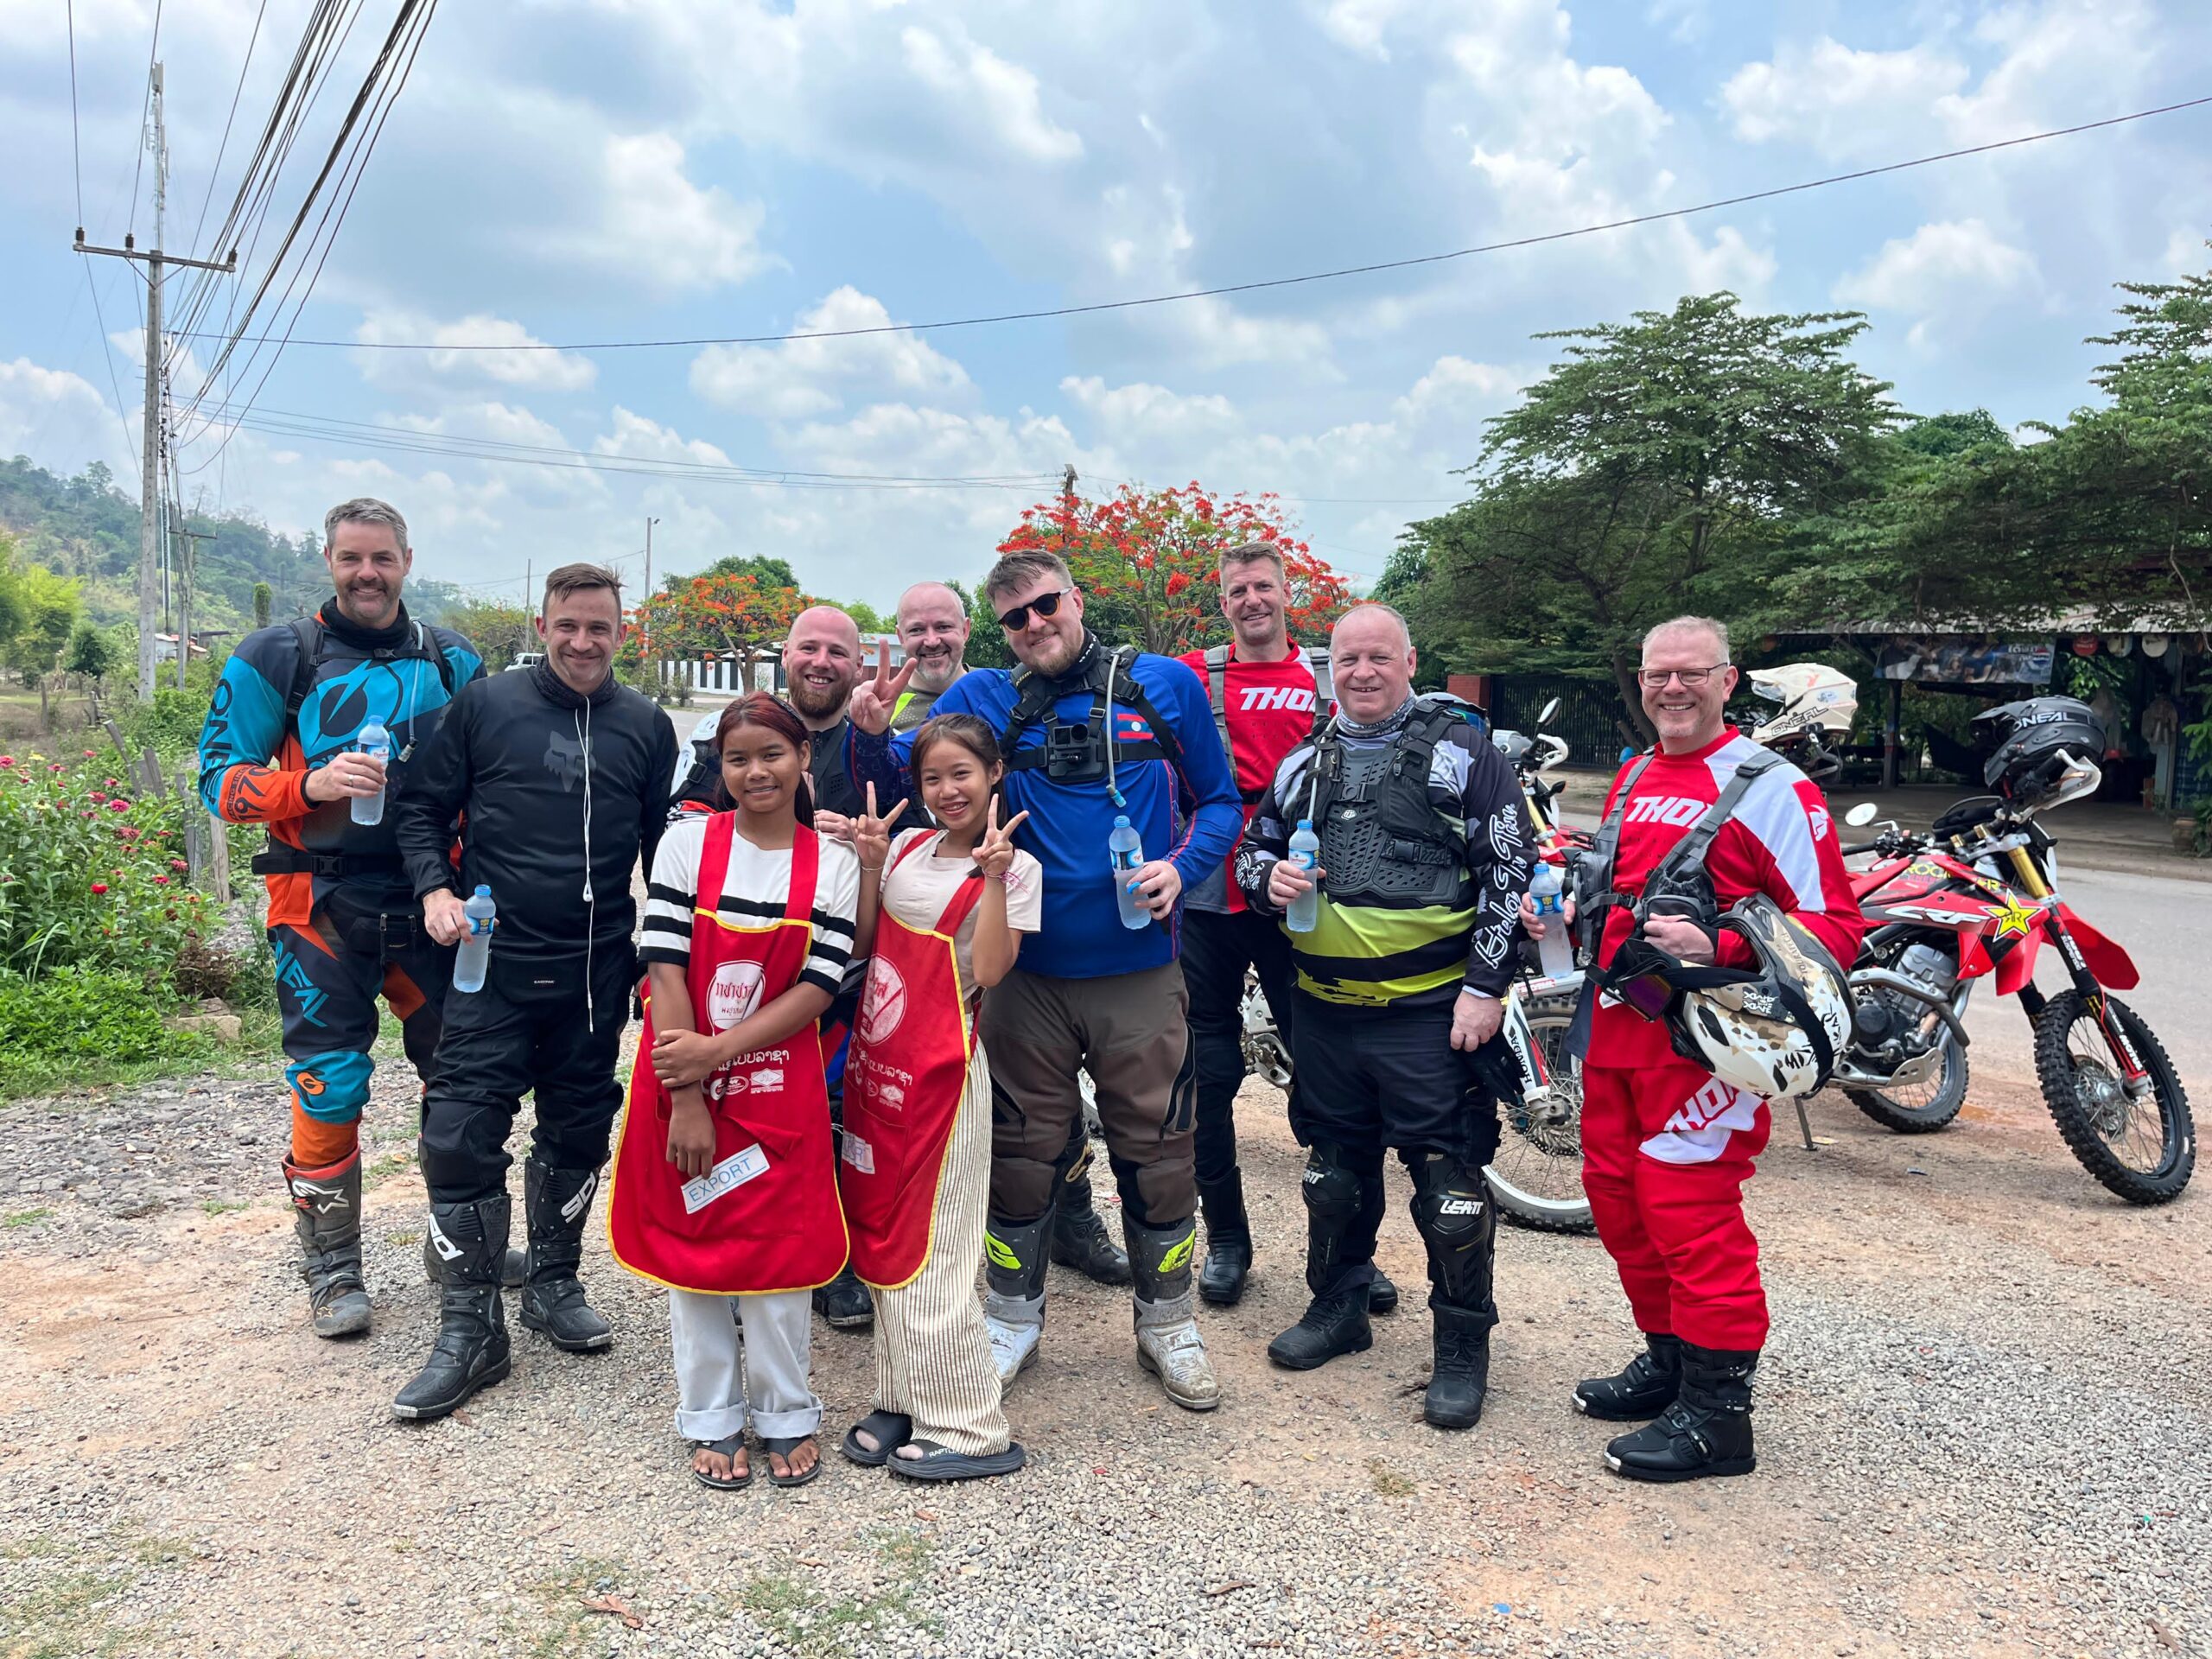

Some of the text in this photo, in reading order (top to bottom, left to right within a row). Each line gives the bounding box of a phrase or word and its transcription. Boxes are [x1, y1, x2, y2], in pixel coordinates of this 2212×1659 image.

[1239, 686, 1316, 713] THO
[1510, 1035, 1533, 1084] HONDA
[688, 1158, 753, 1203] EXPORT
